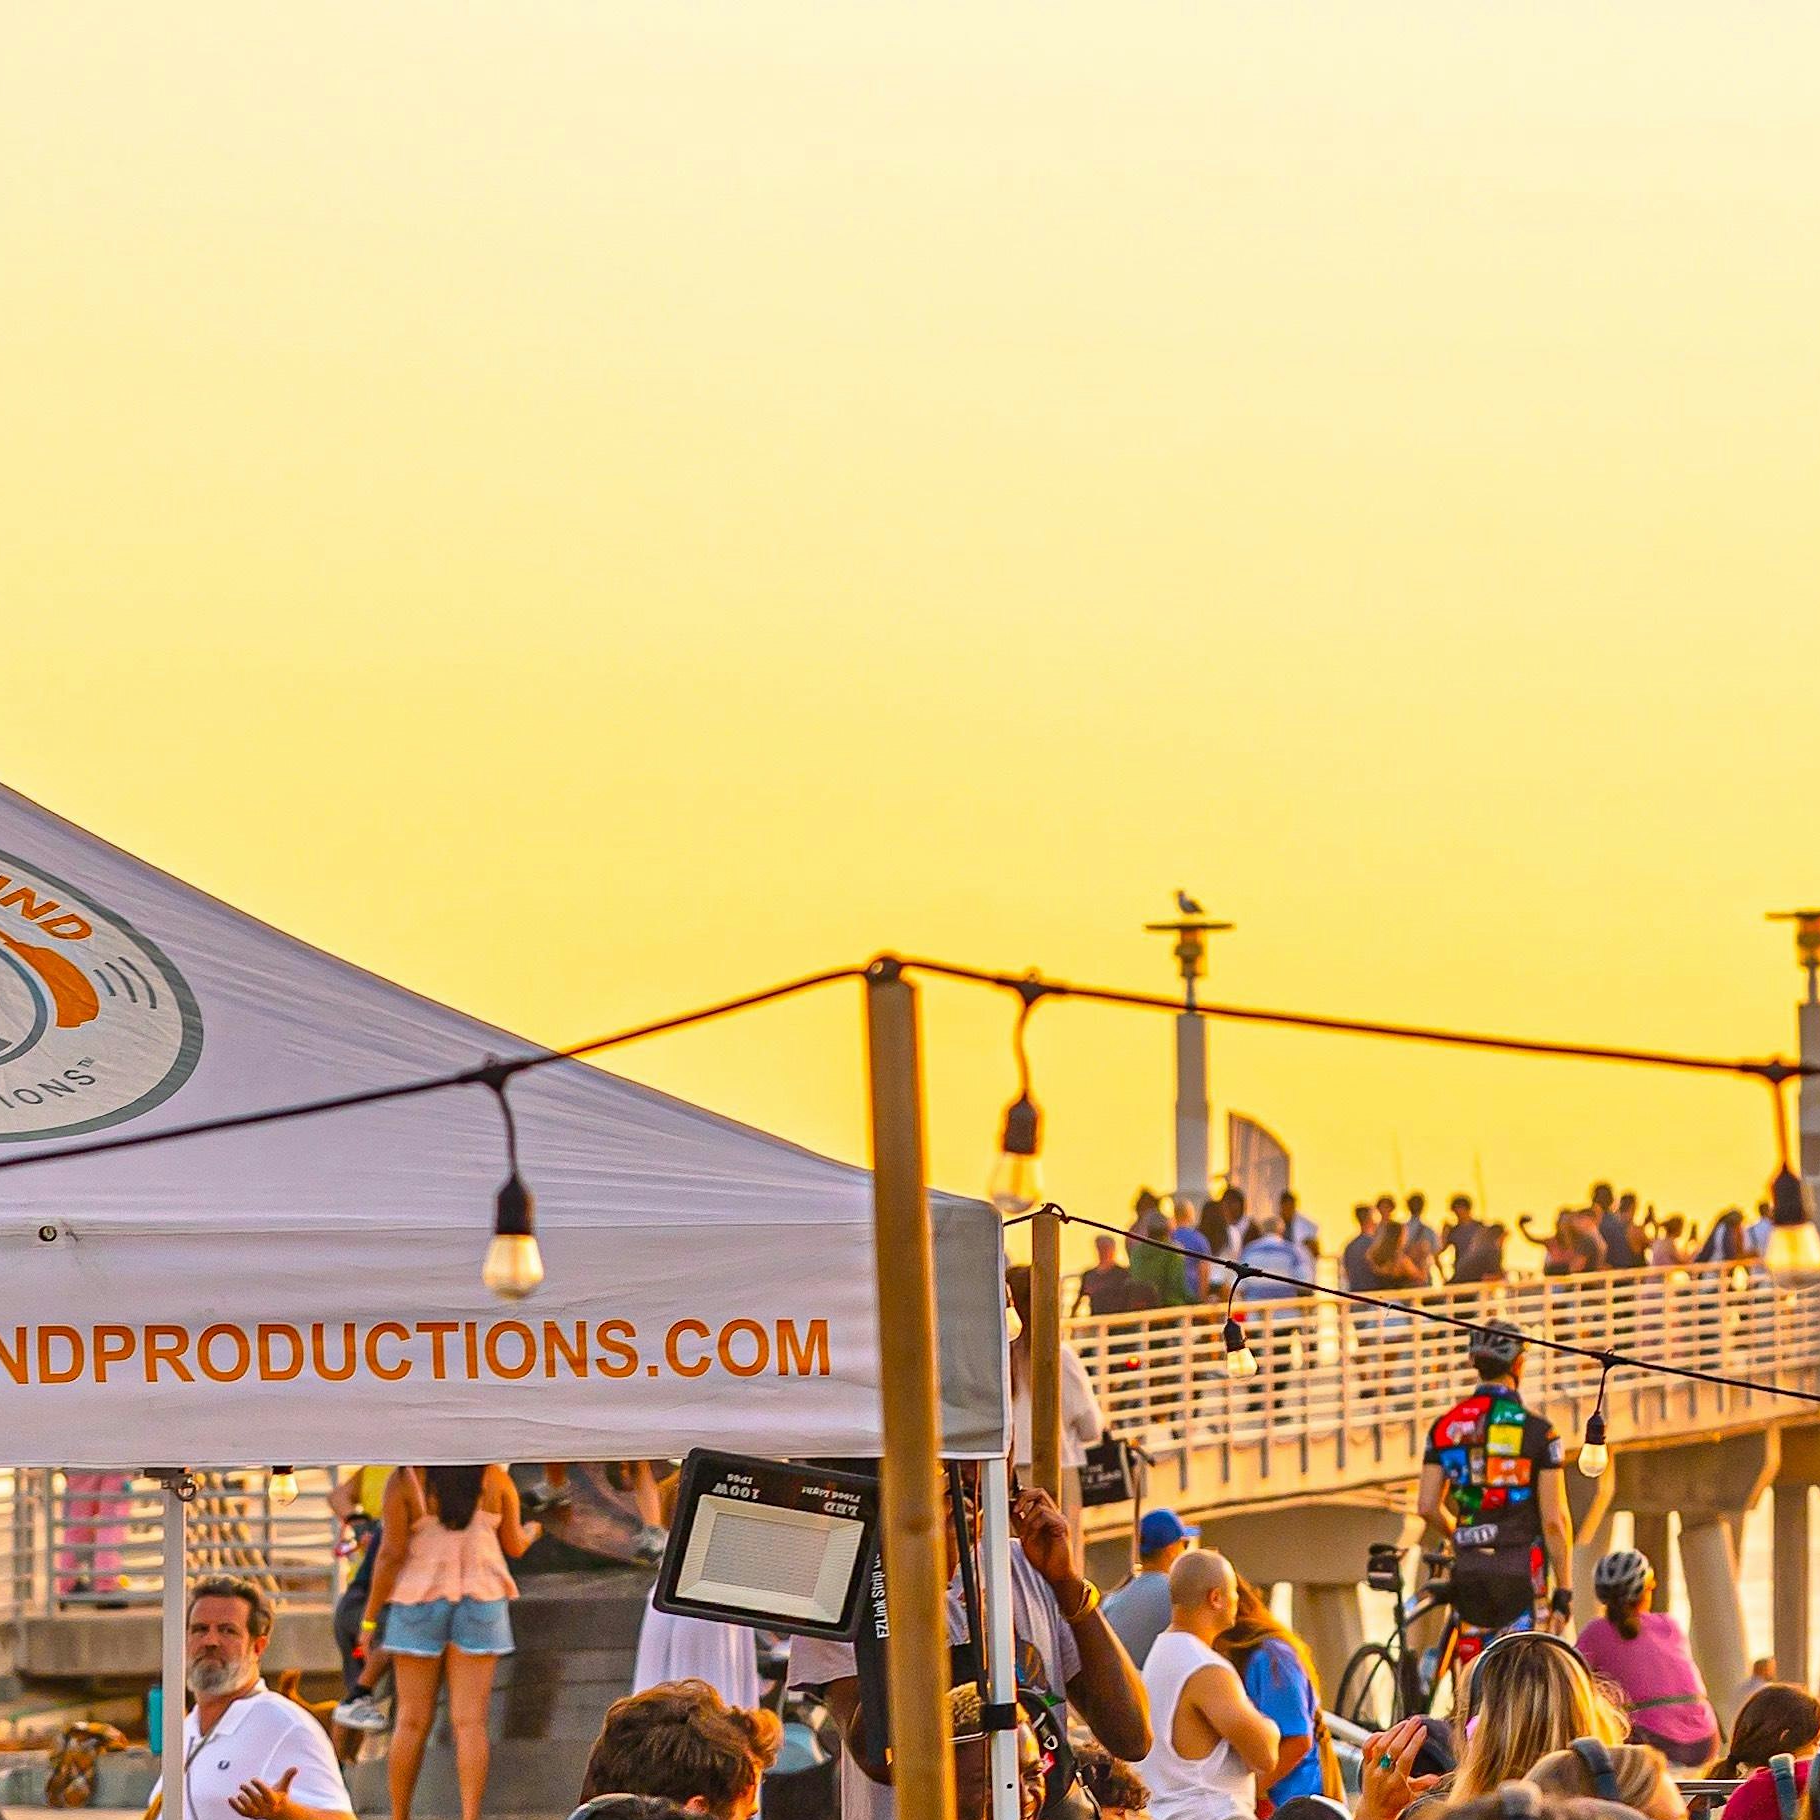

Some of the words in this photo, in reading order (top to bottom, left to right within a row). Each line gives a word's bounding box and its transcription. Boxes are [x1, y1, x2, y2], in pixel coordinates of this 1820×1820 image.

[712, 1482, 761, 1500] 100W
[801, 1486, 831, 1499] Light
[831, 1490, 861, 1503] Flood
[824, 1502, 859, 1516] LED
[870, 1570, 886, 1599] Strip
